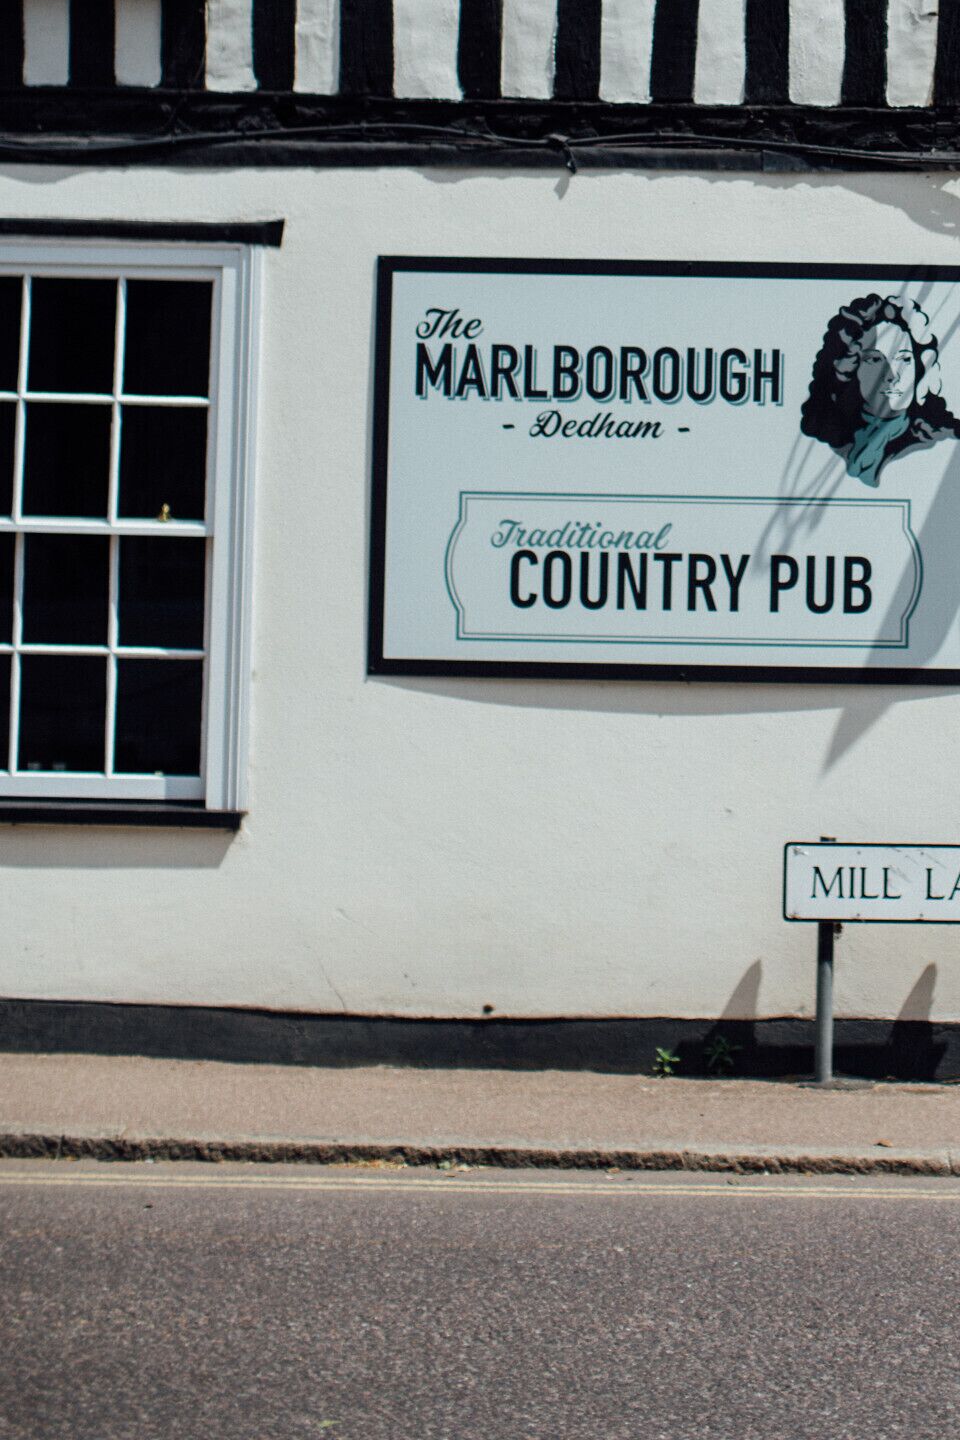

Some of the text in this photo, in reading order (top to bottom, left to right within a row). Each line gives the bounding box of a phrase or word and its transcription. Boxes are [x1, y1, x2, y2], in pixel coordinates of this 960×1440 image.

[415, 308, 484, 341] The
[414, 342, 783, 405] MARLBOROUGH
[528, 410, 665, 440] Dedham
[490, 519, 673, 551] Traditional
[510, 549, 874, 615] COUNTRY PUB
[811, 866, 902, 899] MILL
